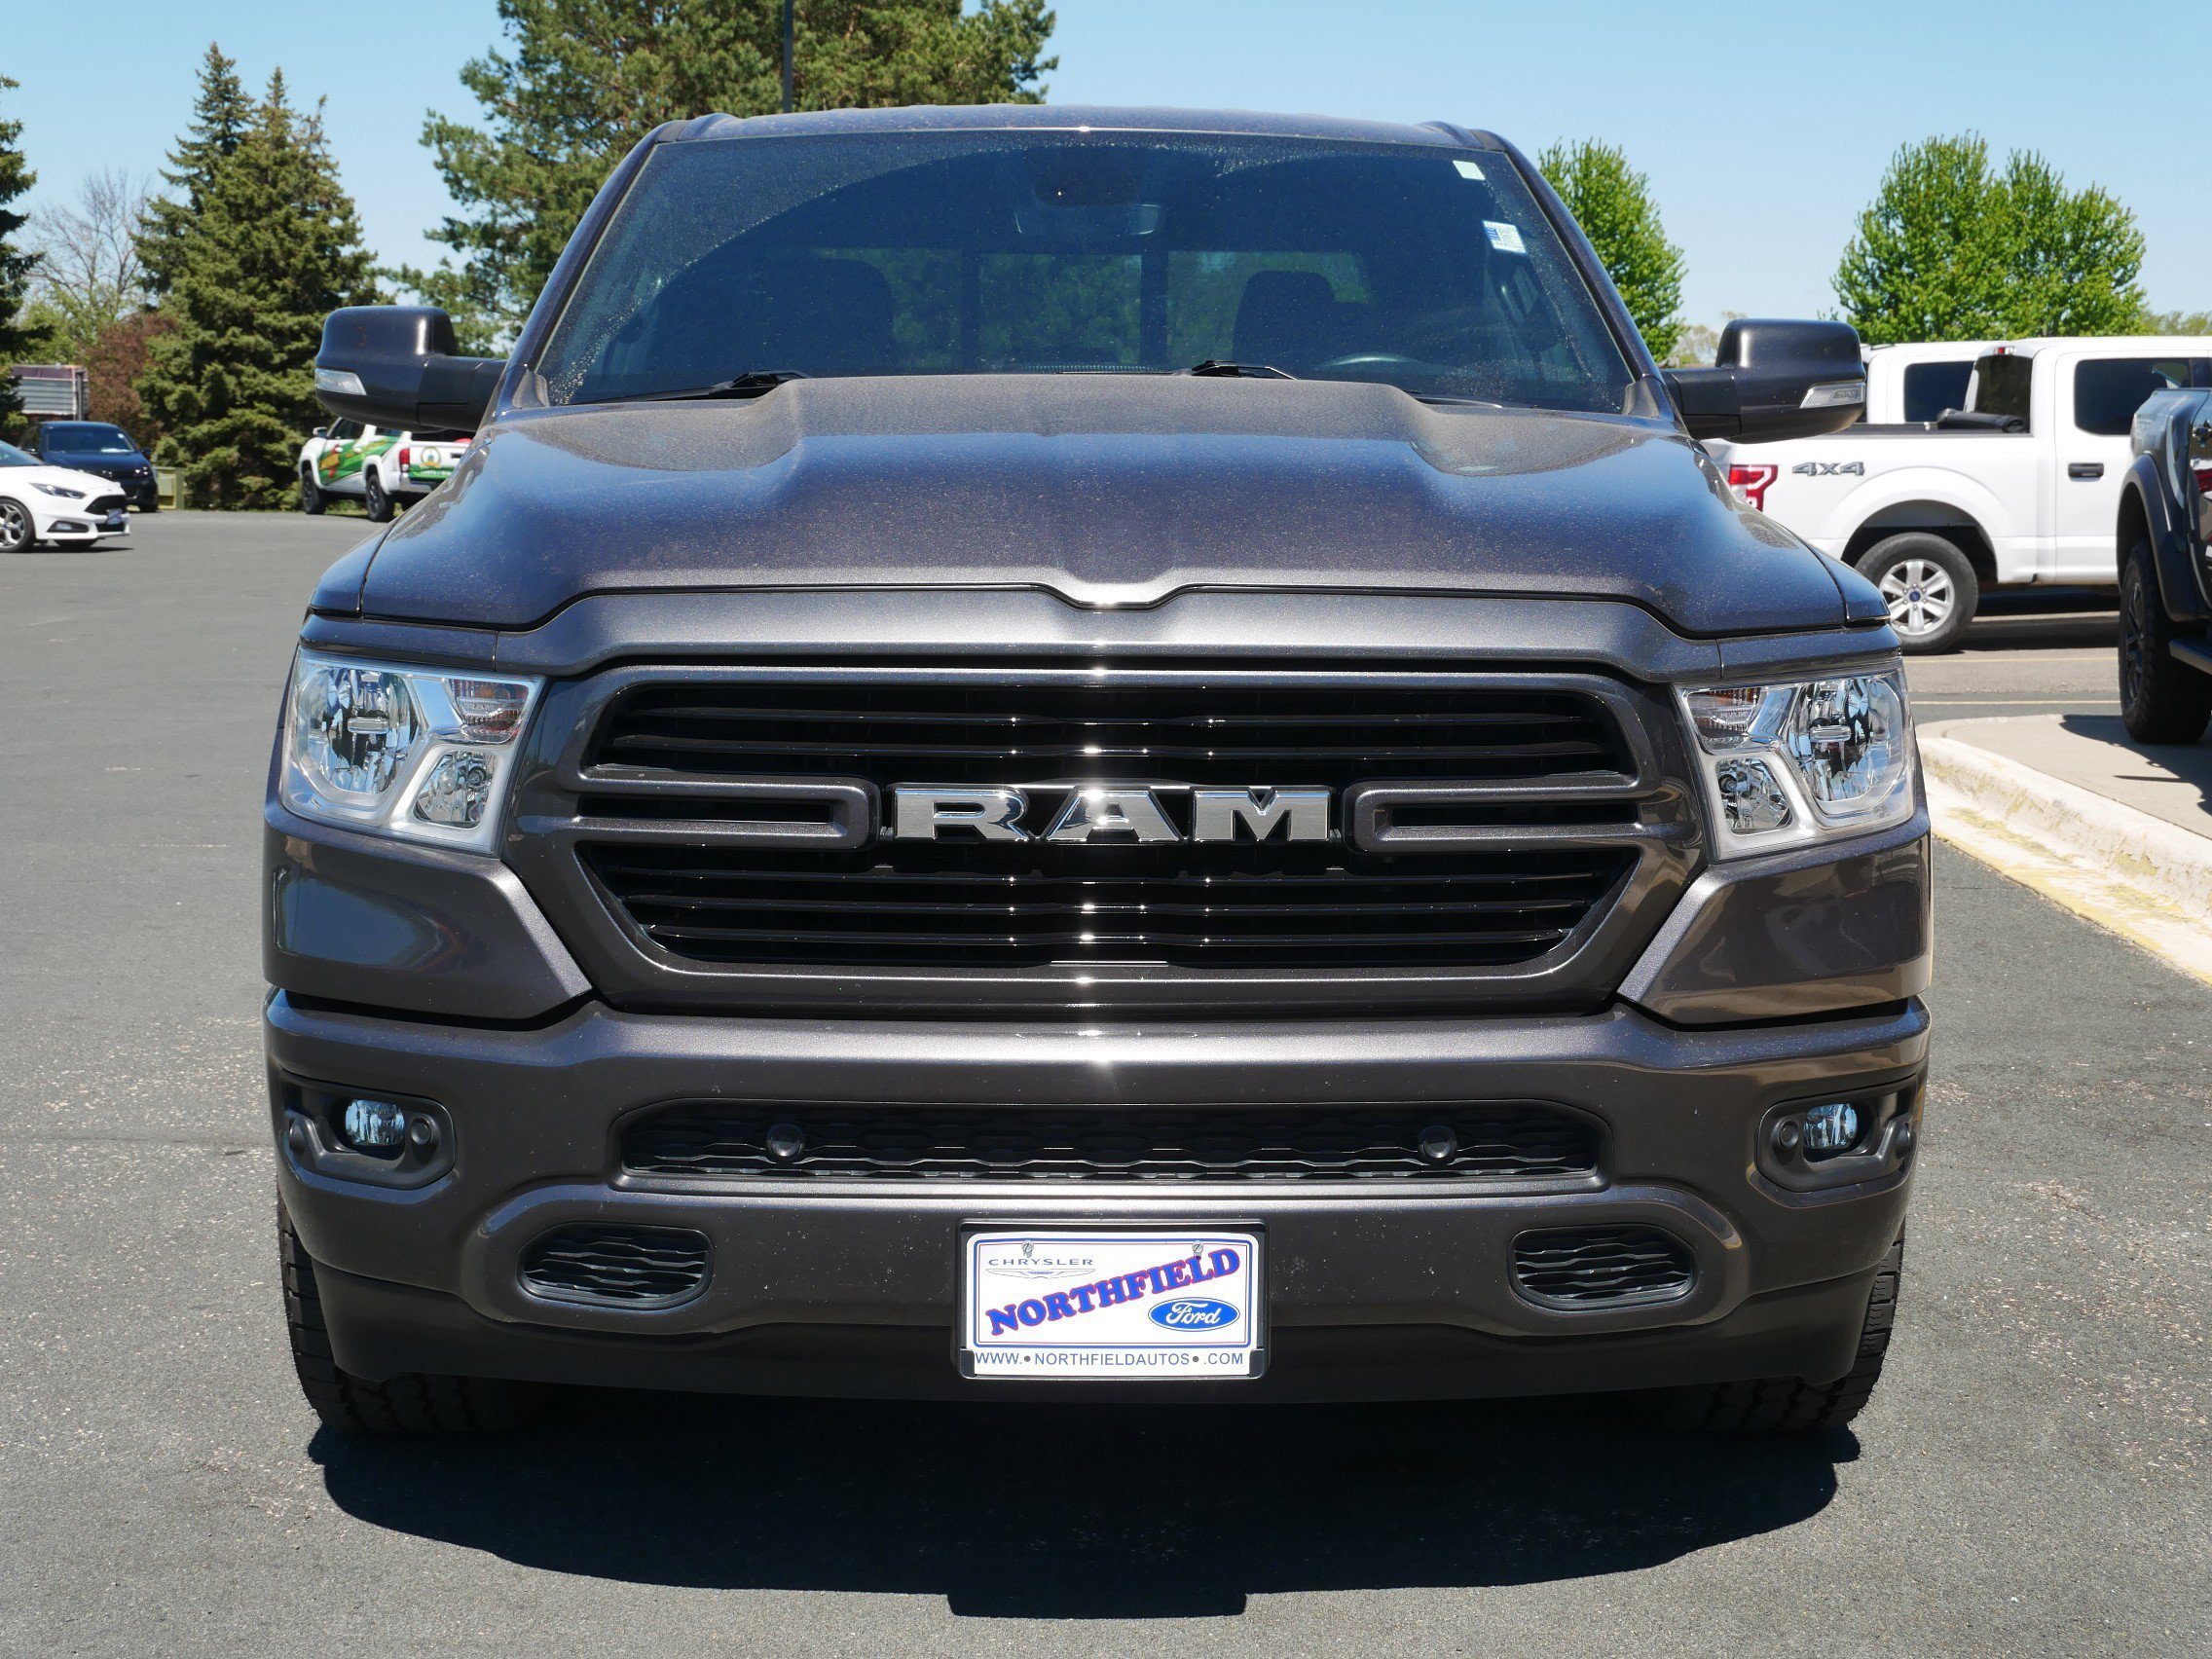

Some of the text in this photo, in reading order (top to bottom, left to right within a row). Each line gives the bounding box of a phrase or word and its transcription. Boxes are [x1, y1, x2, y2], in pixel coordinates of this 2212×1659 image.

[894, 786, 1332, 842] RAM
[987, 1258, 1093, 1267] CHRYSLER
[985, 1248, 1241, 1336] NORTHFIELD
[1164, 1301, 1221, 1325] Ford
[1034, 1352, 1191, 1366] NORTHFIELDAUTOS
